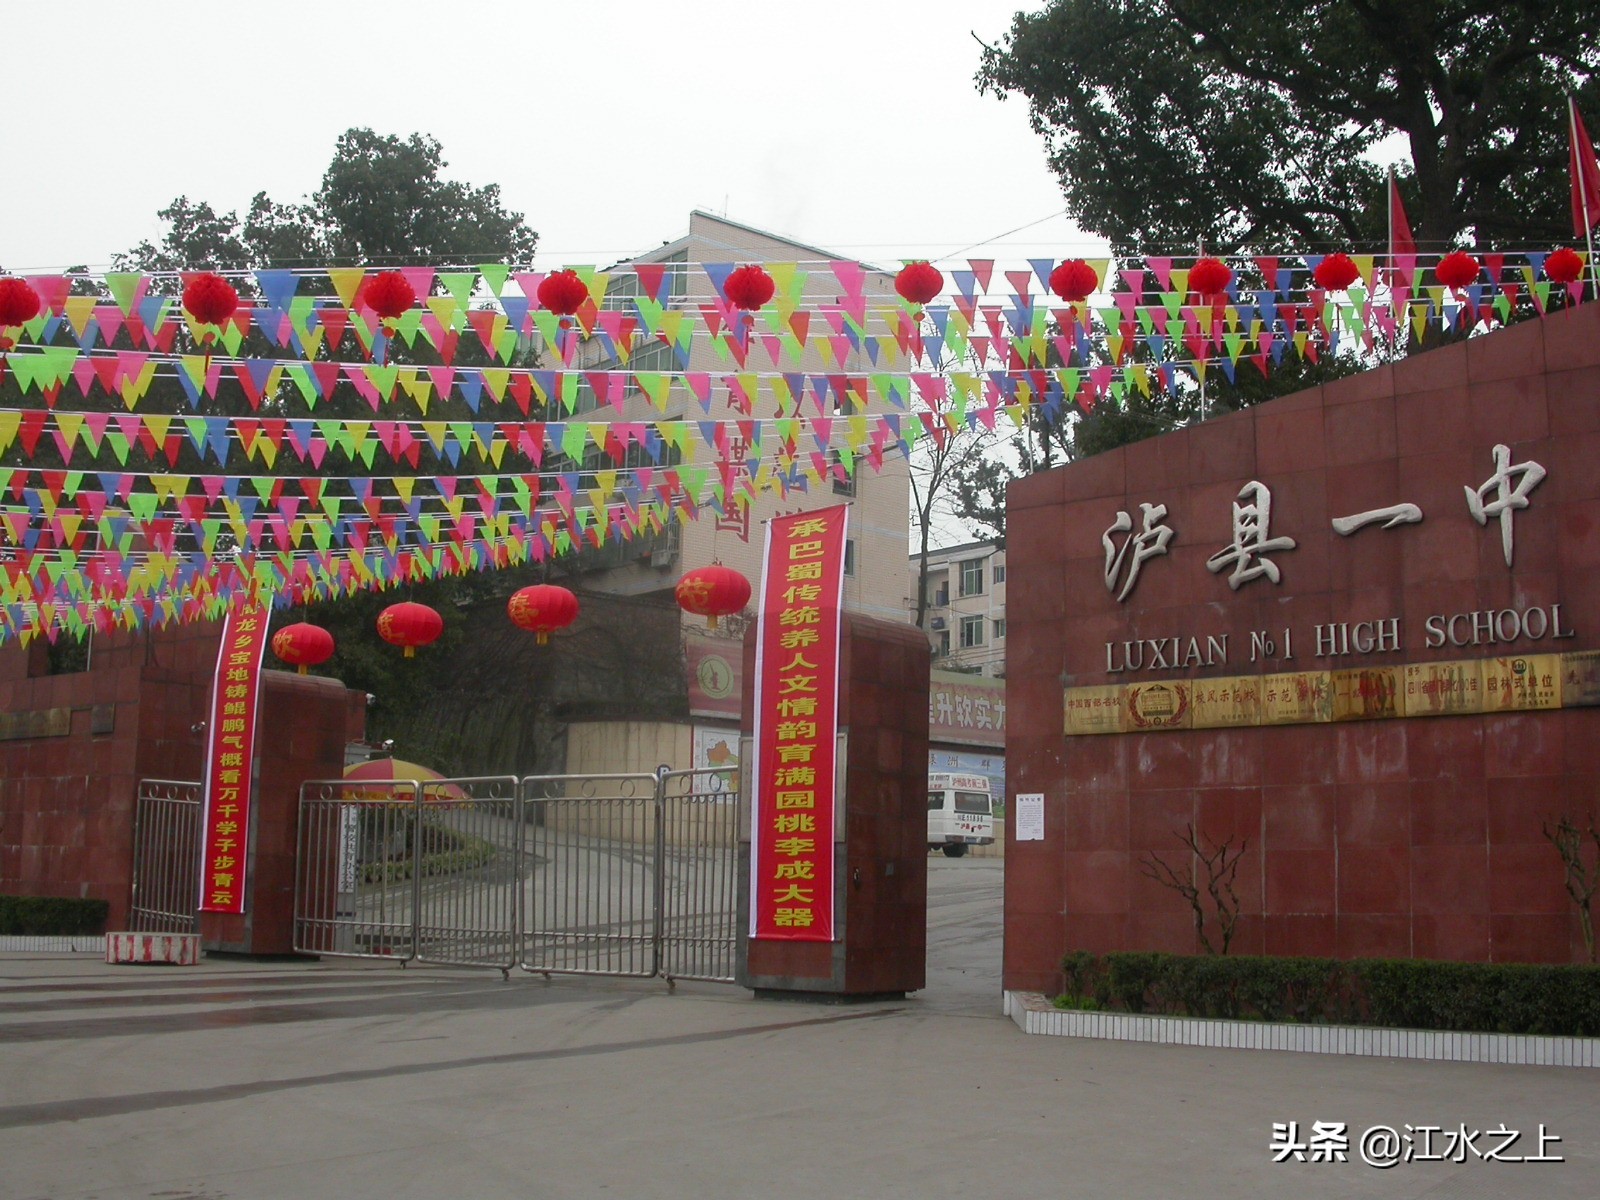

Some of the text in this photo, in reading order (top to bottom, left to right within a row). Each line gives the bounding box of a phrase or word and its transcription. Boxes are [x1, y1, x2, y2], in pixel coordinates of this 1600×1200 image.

[1102, 443, 1547, 602] 泸县一中
[1105, 634, 1229, 673] LUXIAN
[1314, 618, 1401, 657] HIGH
[1425, 604, 1575, 649] SCHOOL
[1487, 674, 1553, 692] 园林式单位
[773, 517, 828, 927] 承巴蜀传统养人文情韵育满园桃李成大器
